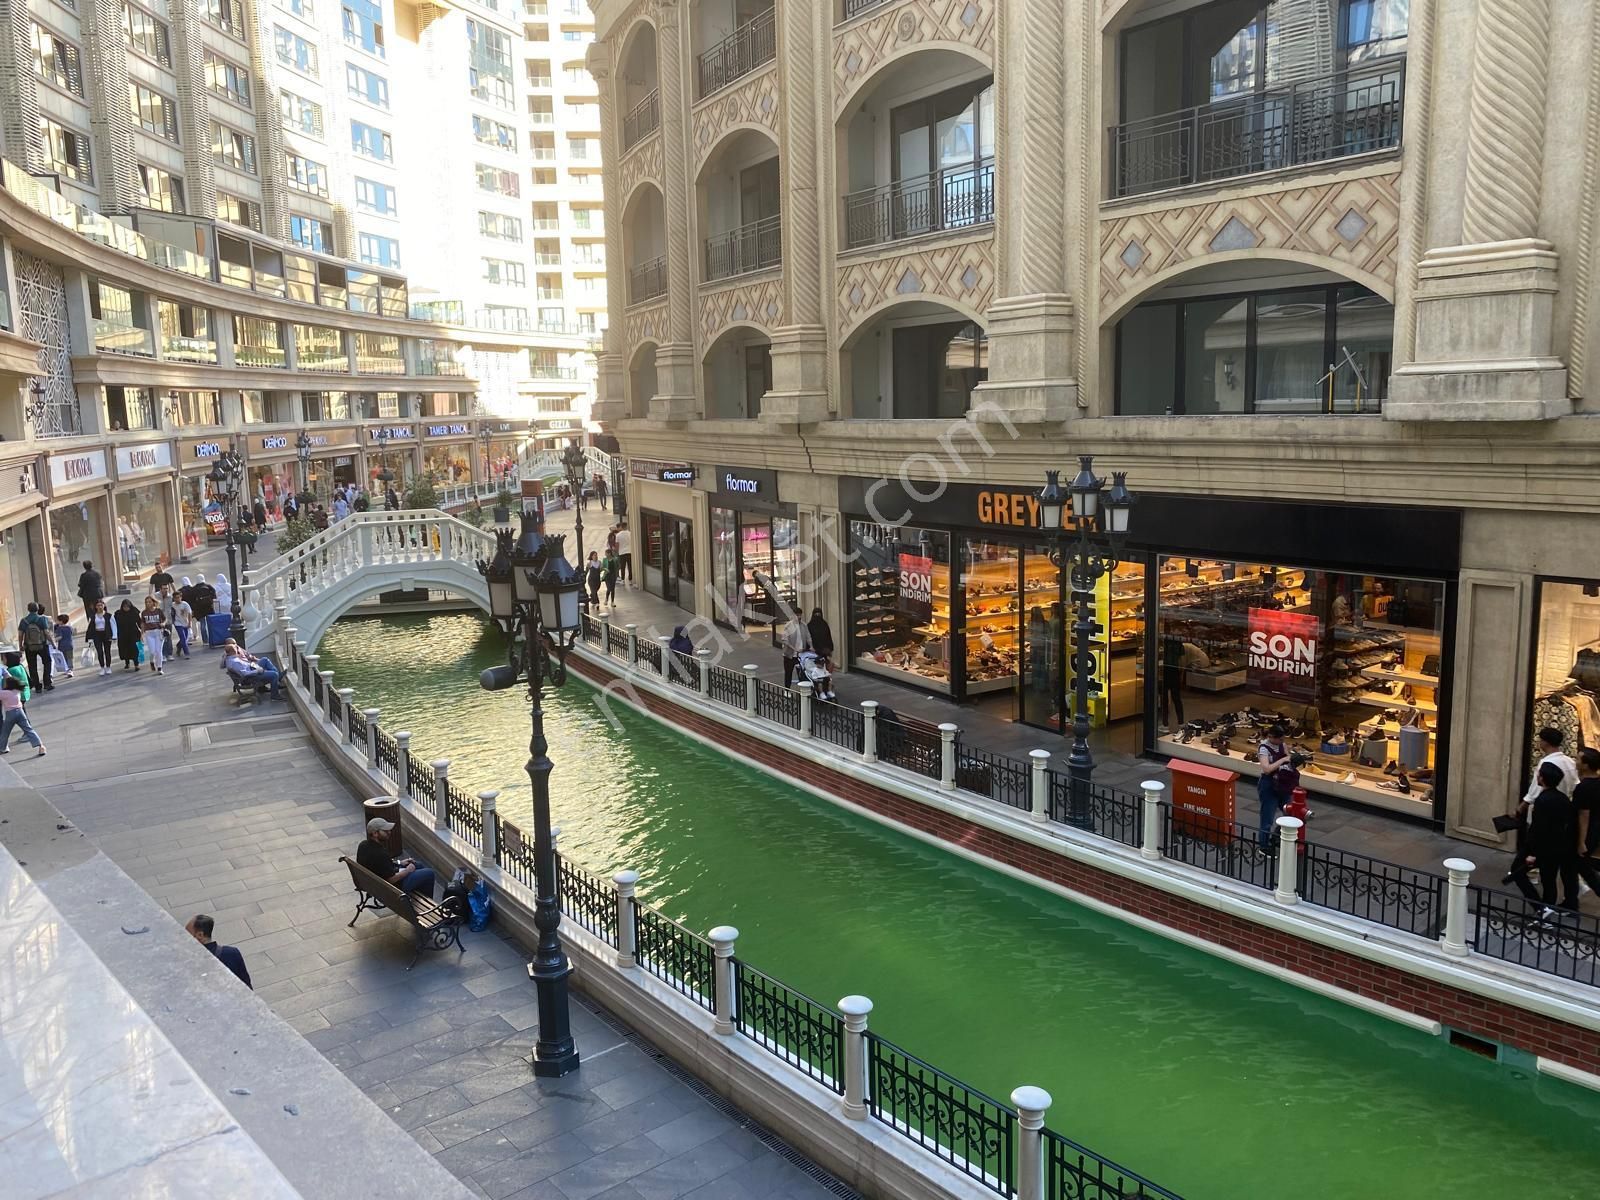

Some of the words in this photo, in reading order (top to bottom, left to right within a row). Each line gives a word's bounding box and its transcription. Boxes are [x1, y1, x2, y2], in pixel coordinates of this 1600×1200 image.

[663, 471, 693, 481] flormar
[726, 473, 758, 493] flormar
[900, 570, 931, 593] SON
[1249, 631, 1316, 663] SON
[1186, 785, 1207, 796] YANGIN
[1183, 802, 1195, 812] FIRE
[1196, 806, 1211, 815] HOSE
